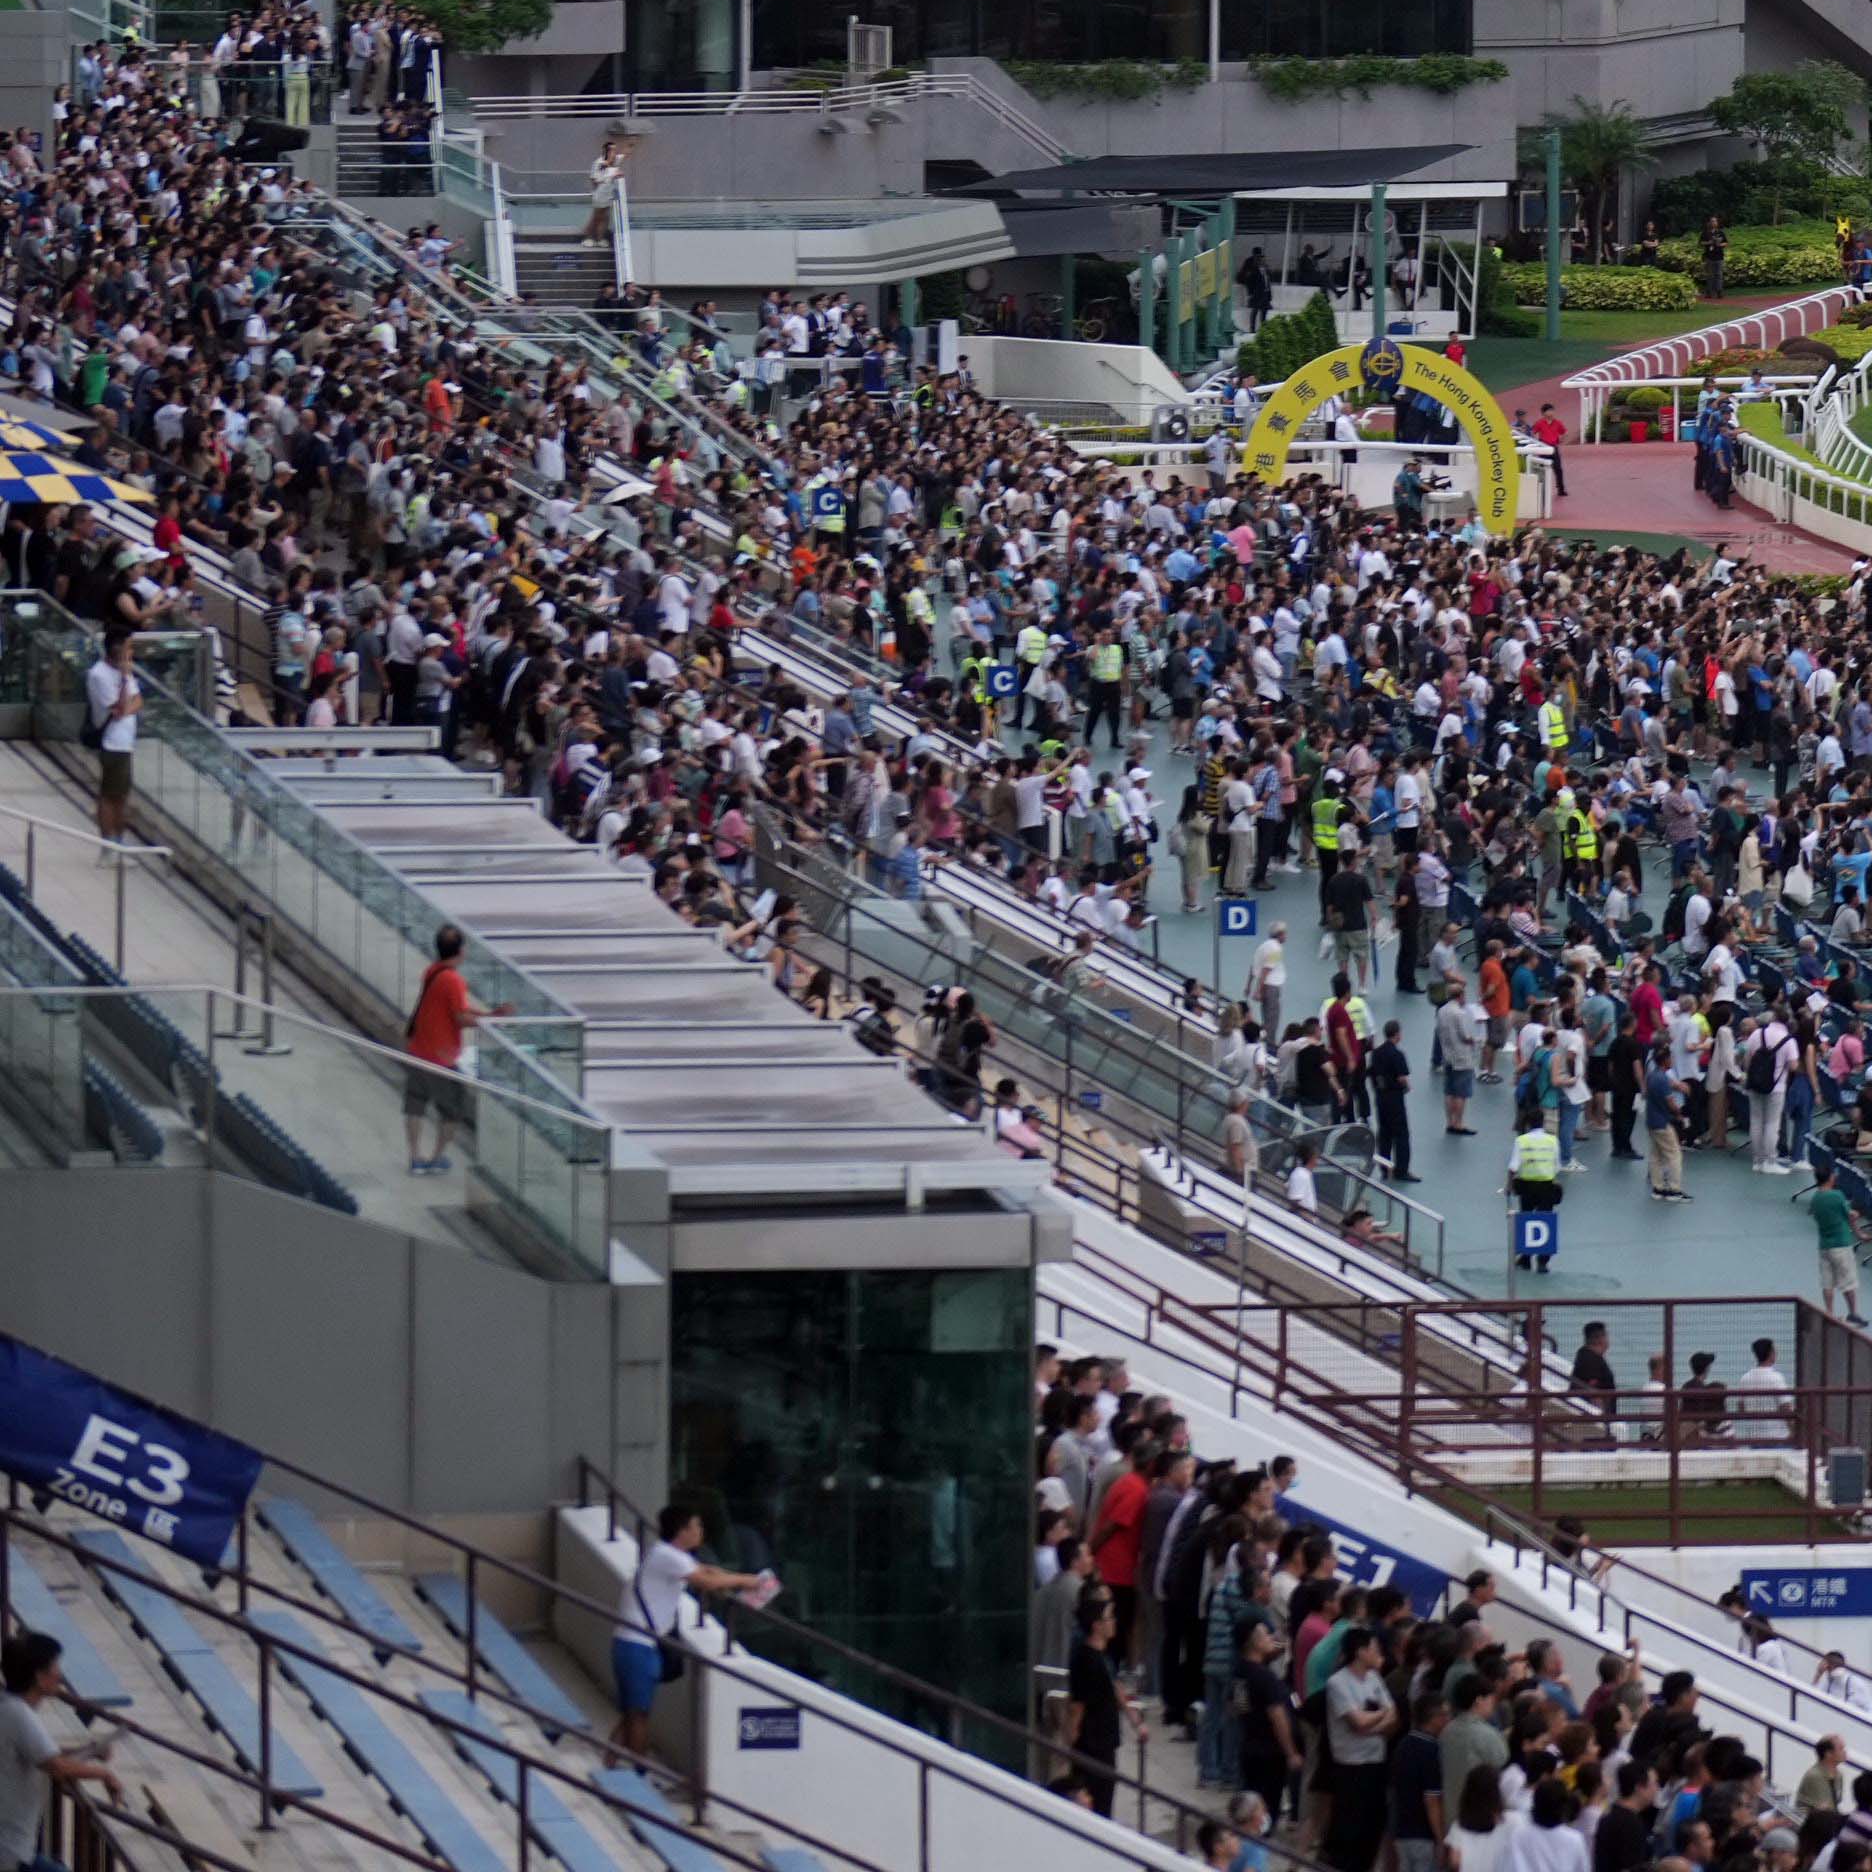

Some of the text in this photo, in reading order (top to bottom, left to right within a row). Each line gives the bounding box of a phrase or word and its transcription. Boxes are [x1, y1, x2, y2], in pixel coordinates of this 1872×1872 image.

[1413, 361, 1506, 518] The Hong Kong Jockey Club
[818, 492, 839, 511] C
[993, 670, 1014, 692] C
[1227, 906, 1250, 930] D
[1524, 1219, 1550, 1249] D
[69, 1413, 191, 1506] E3
[47, 1467, 182, 1543] Zone 區
